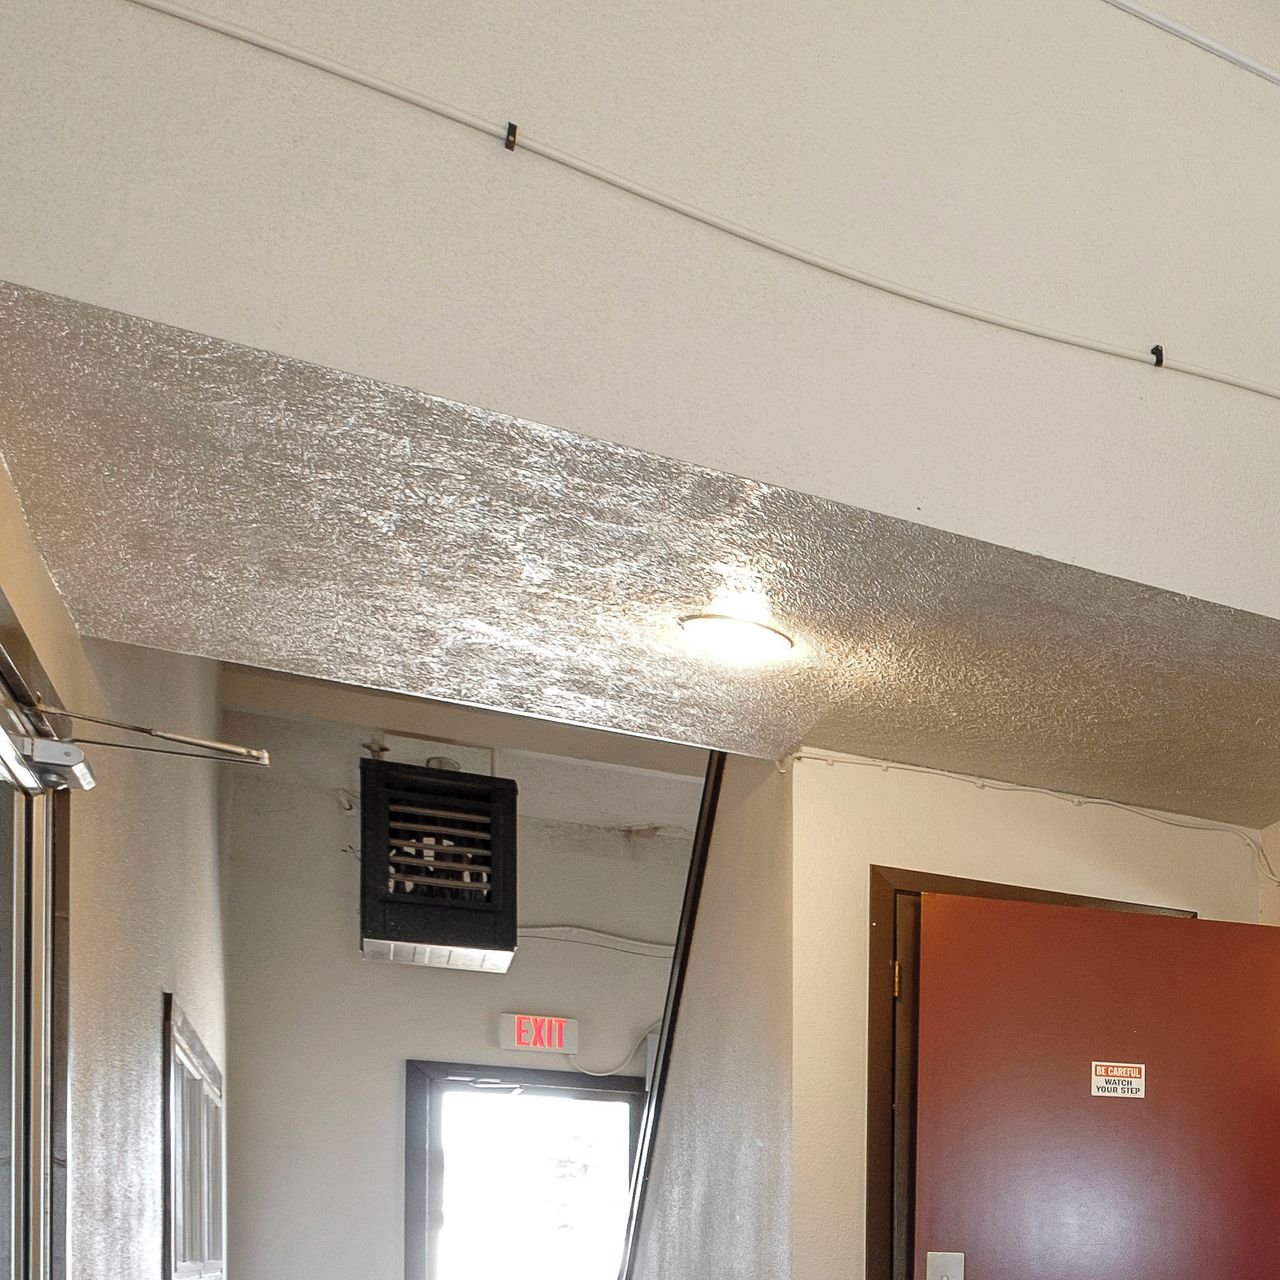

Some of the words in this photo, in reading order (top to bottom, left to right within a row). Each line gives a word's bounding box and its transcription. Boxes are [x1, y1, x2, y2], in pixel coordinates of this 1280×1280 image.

[514, 1015, 567, 1050] EXIT
[1096, 1066, 1107, 1076] BE
[1108, 1066, 1141, 1078] CAREFUL
[1105, 1078, 1132, 1087] WATCH
[1096, 1085, 1118, 1093] YOUR
[1121, 1087, 1140, 1095] STEP
